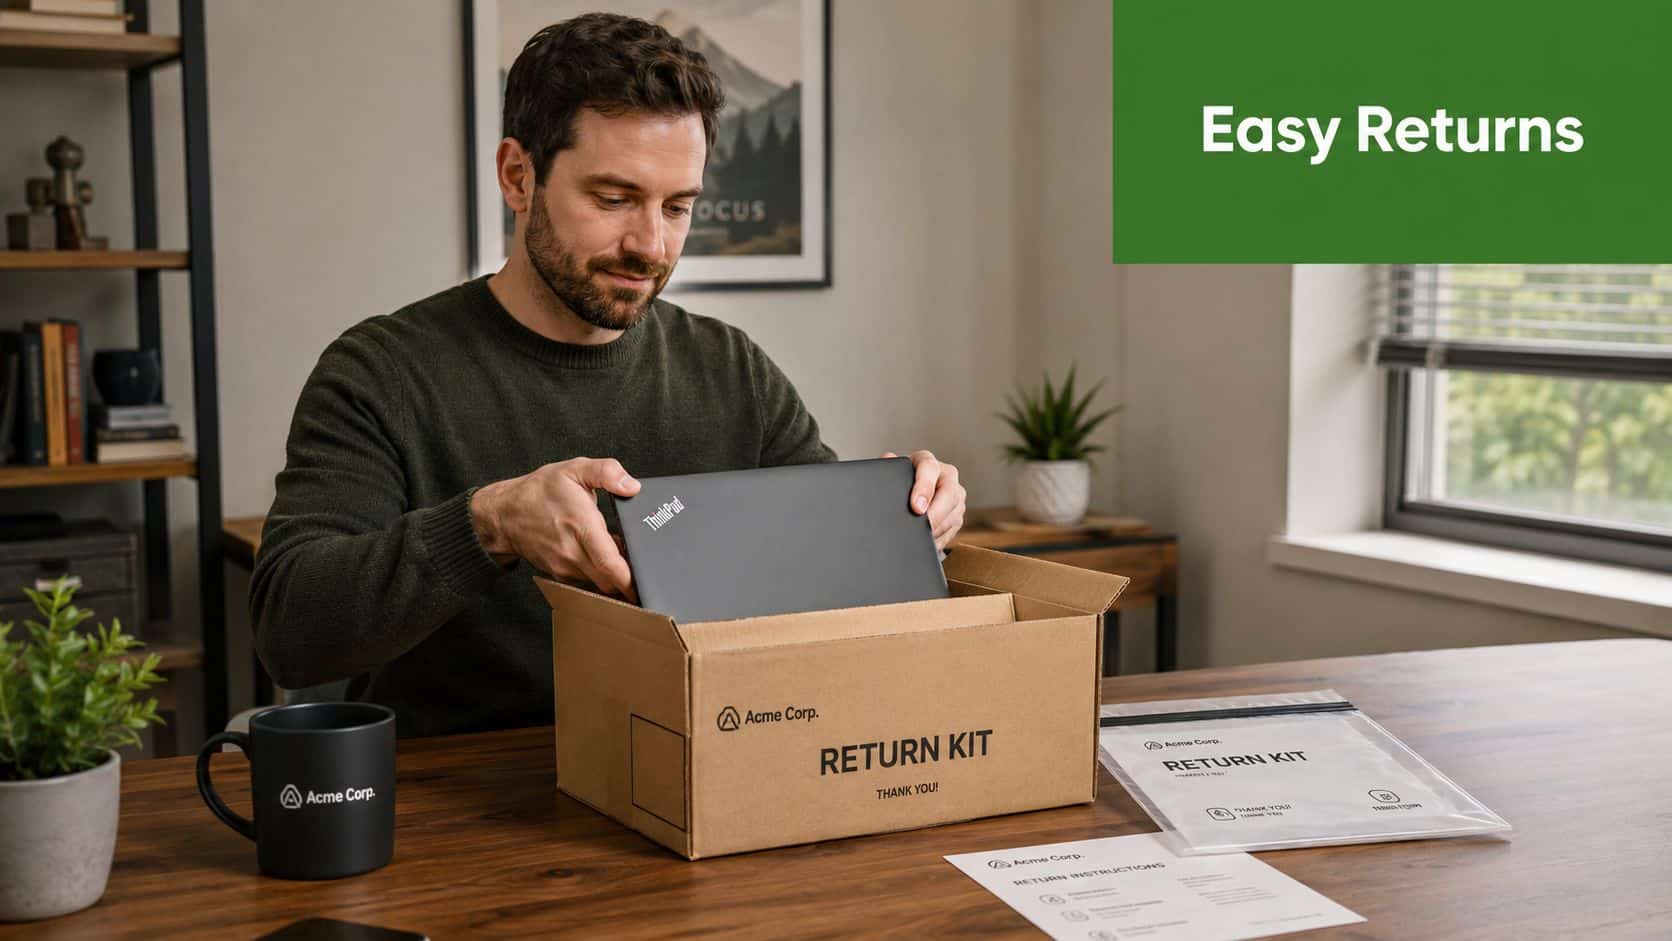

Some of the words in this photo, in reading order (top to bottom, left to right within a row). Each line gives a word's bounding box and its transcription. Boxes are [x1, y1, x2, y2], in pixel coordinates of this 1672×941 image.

[695, 200, 766, 222] OCUS
[642, 495, 685, 531] ThinkPad
[744, 710, 782, 725] Acme
[785, 706, 819, 722] Corp.
[820, 735, 940, 776] RETURN
[948, 729, 993, 760] KIT
[1162, 754, 1268, 771] RETURN
[1268, 751, 1308, 763] KIT
[306, 790, 343, 804] Acme
[345, 787, 376, 801] Corp.
[876, 785, 912, 800] THANK
[915, 782, 939, 795] YOU!
[1013, 858, 1049, 866] Acme
[1049, 852, 1086, 861] Corp.
[1012, 875, 1067, 886] RETURN
[1069, 862, 1166, 879] INSTRUCTIONS
